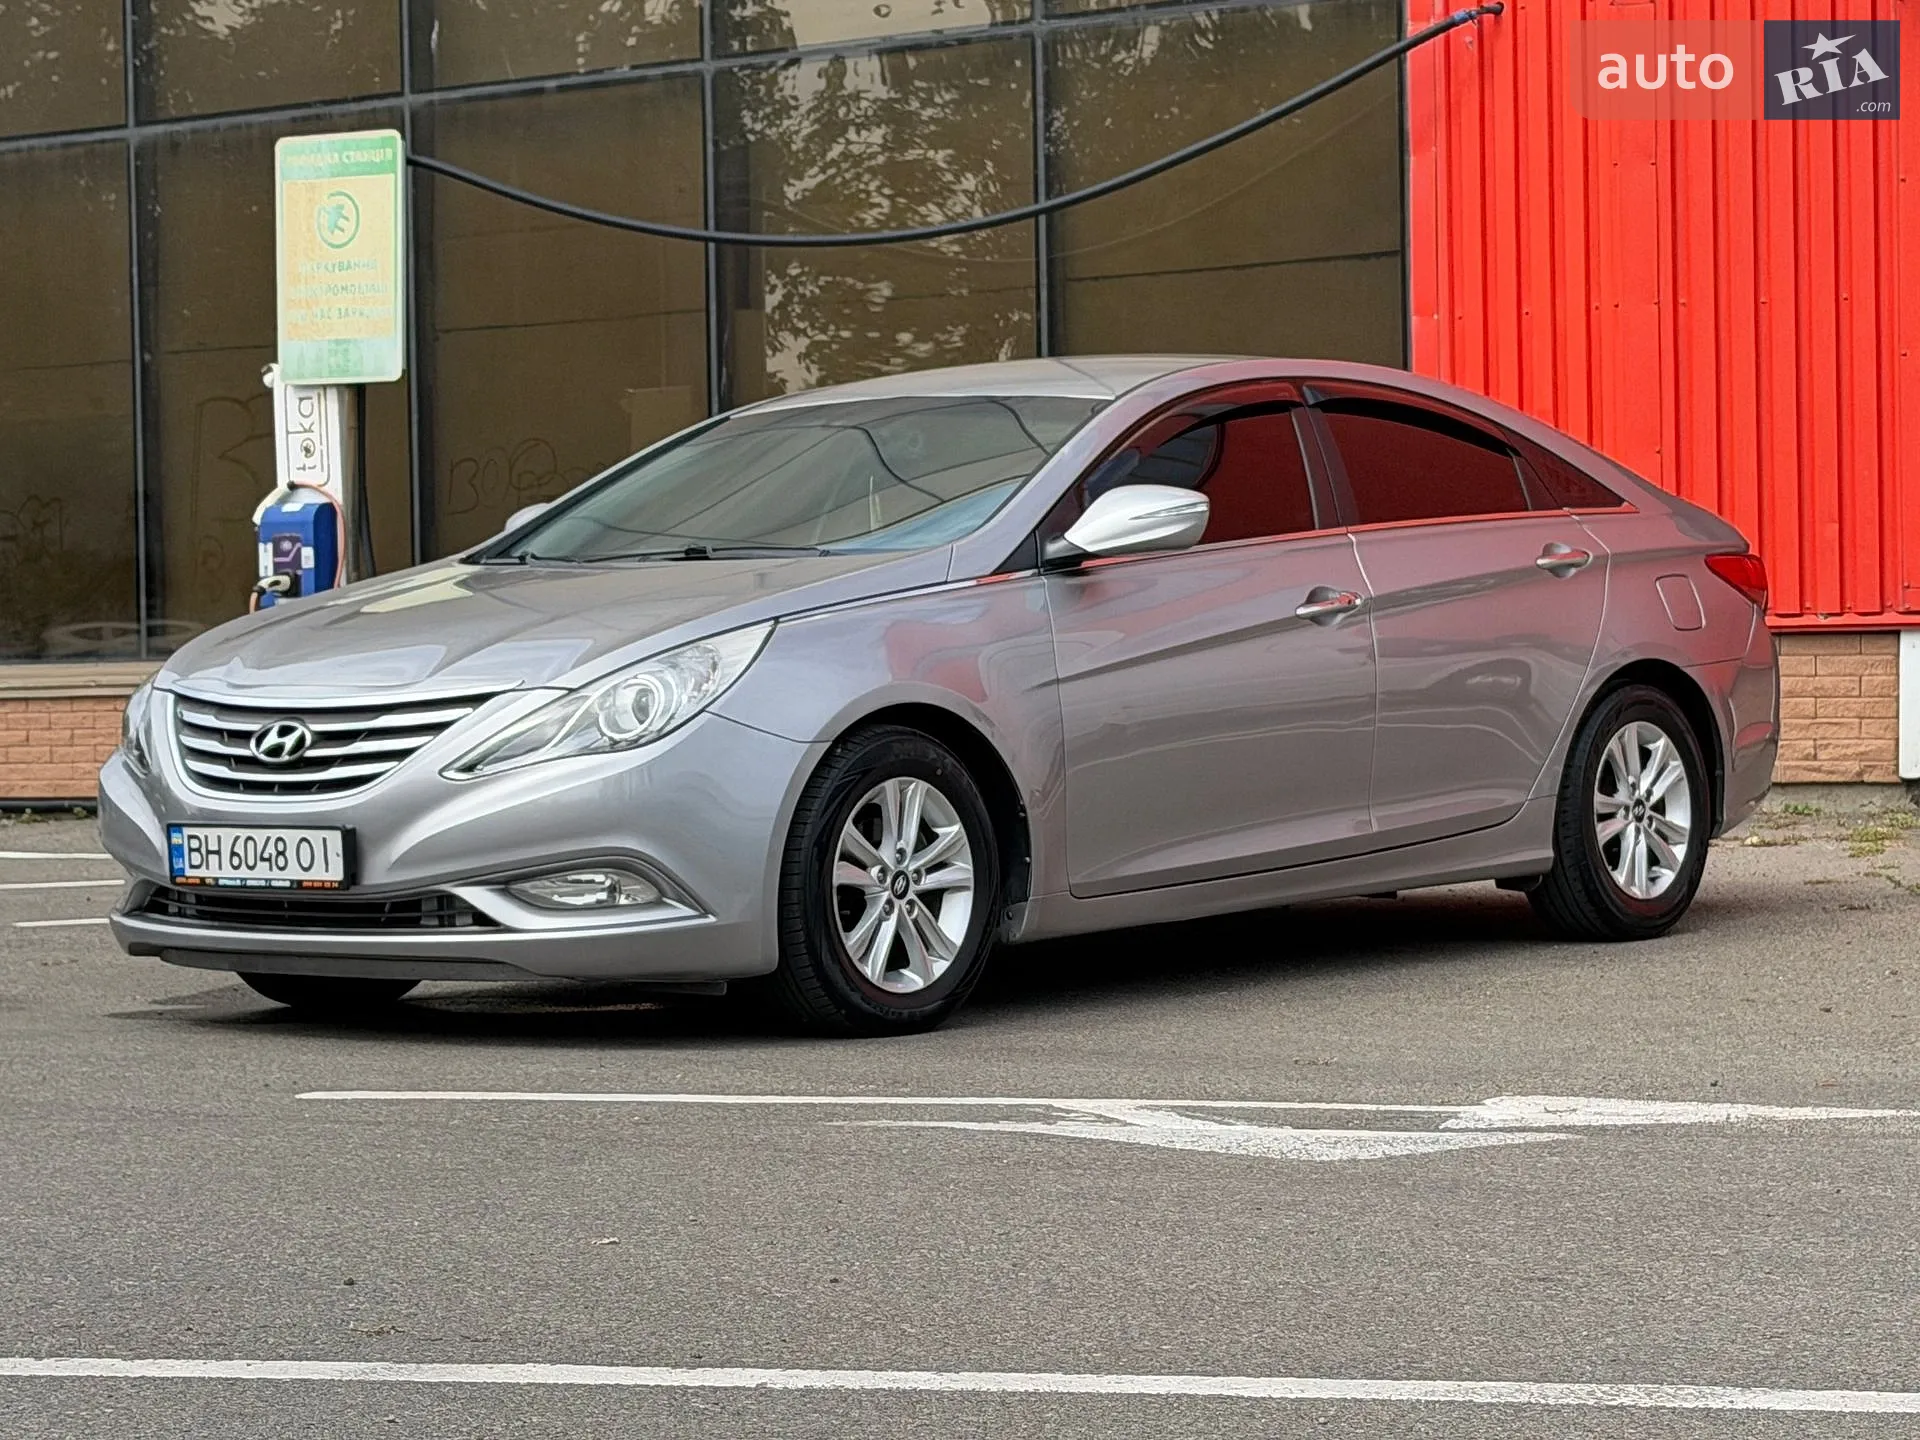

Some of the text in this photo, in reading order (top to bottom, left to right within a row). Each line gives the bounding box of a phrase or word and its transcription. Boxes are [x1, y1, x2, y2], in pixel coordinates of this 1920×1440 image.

[187, 834, 330, 873] BH 6048 OI
